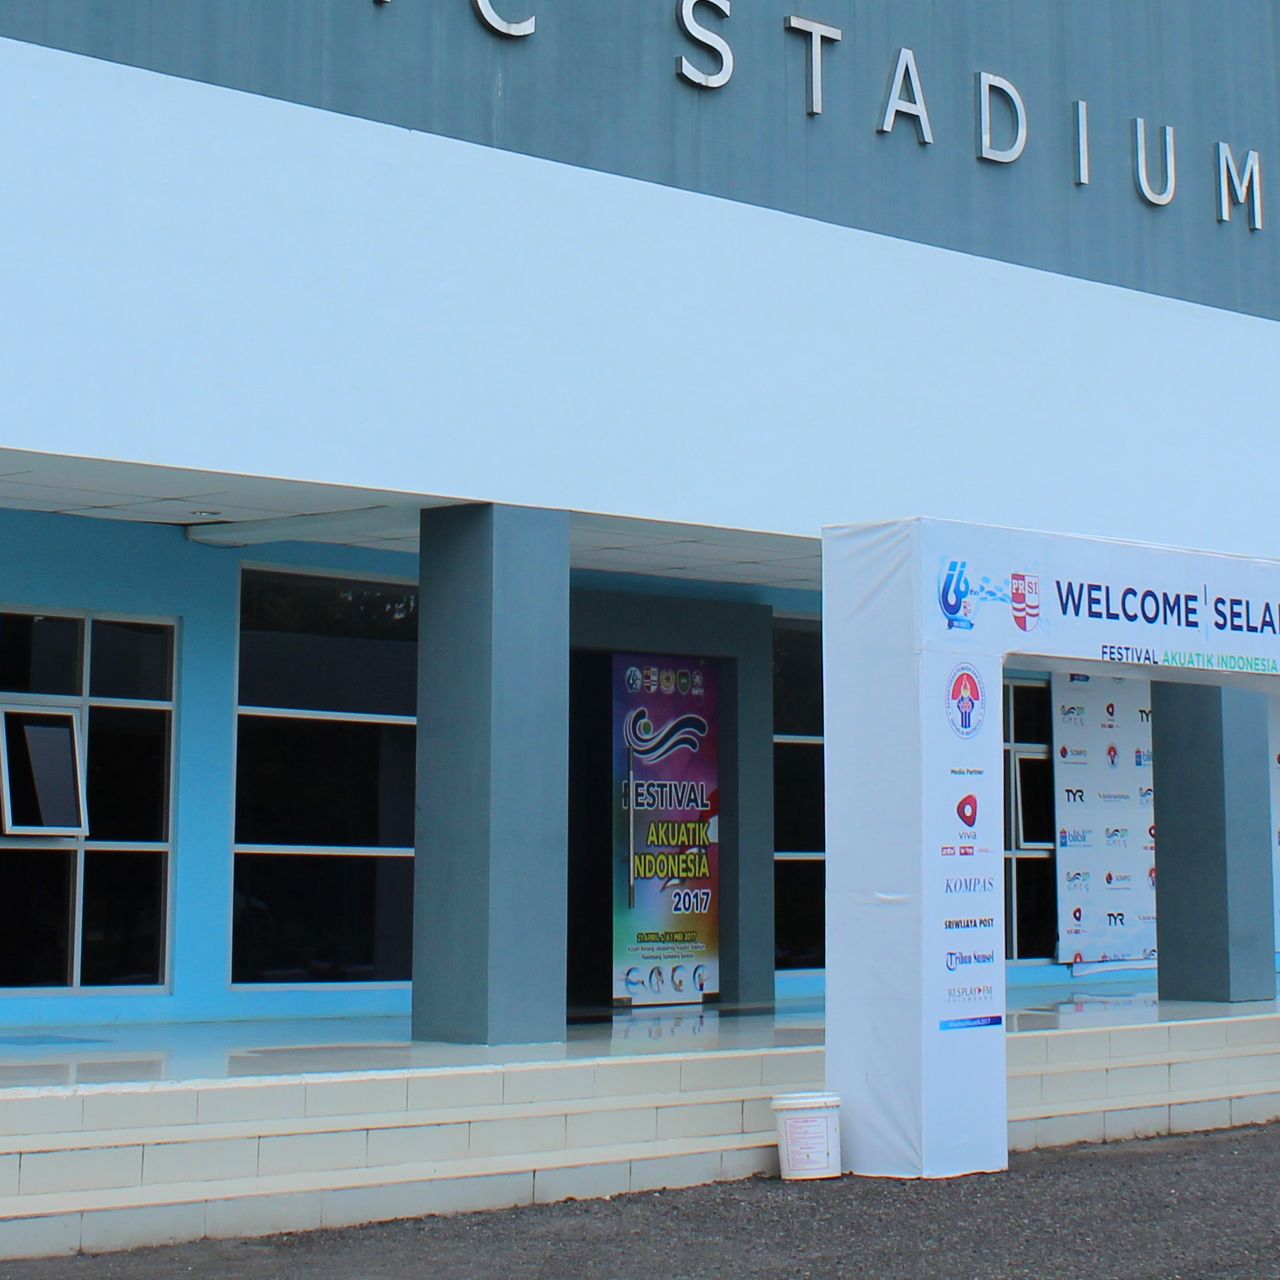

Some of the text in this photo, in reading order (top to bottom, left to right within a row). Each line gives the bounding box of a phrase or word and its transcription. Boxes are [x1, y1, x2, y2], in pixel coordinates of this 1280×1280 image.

[1056, 580, 1199, 628] WELCOME
[1102, 645, 1158, 664] FESTIVAL
[1162, 650, 1214, 668] AKUATIK
[1217, 654, 1279, 673] INDONESIA
[1065, 789, 1085, 802] TYR
[647, 821, 710, 846] AKUATIK
[634, 854, 710, 879] NDONESIA
[945, 877, 995, 893] KOMPAS
[672, 889, 712, 913] 2017
[979, 918, 994, 928] POST
[1107, 913, 1125, 926] TYR
